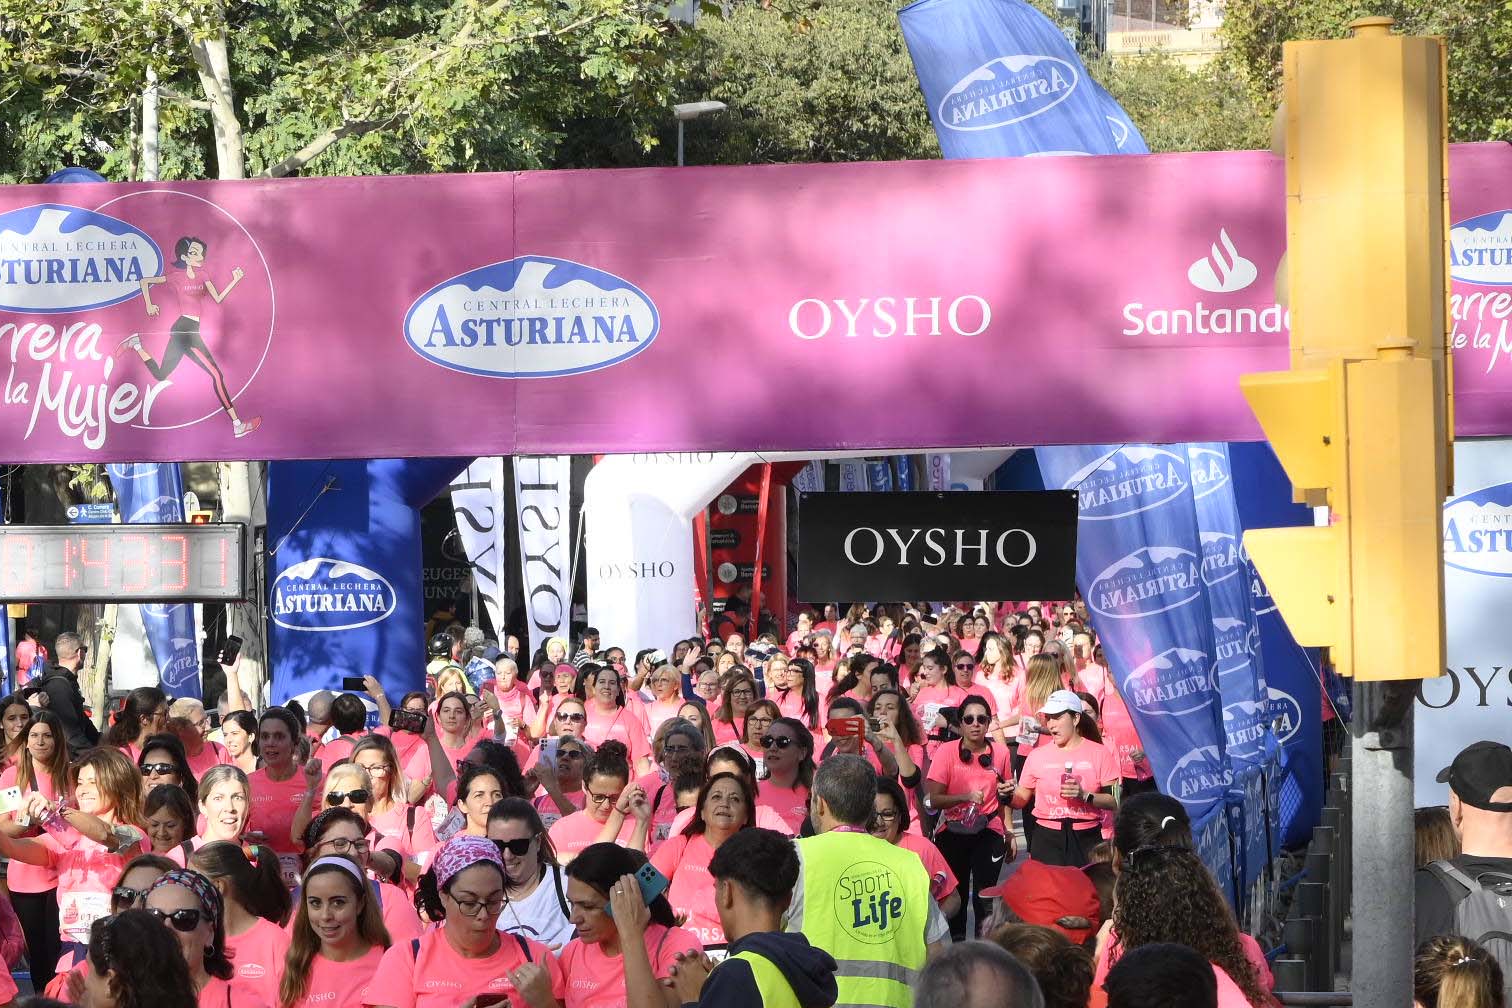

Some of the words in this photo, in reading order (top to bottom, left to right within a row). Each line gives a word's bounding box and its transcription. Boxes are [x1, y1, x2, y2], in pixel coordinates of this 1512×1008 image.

[66, 239, 138, 252] LECHERA
[464, 300, 543, 312] CENTRAL
[549, 296, 630, 310] LECHERA
[789, 295, 991, 339] OYSHO
[424, 303, 639, 348] ASTURIANA
[4, 365, 28, 405] la
[25, 358, 173, 449] Mujer
[844, 528, 1038, 567] OYSHO
[275, 587, 387, 615] ASTURIANA
[839, 870, 892, 900] Sport
[852, 891, 902, 930] Life
